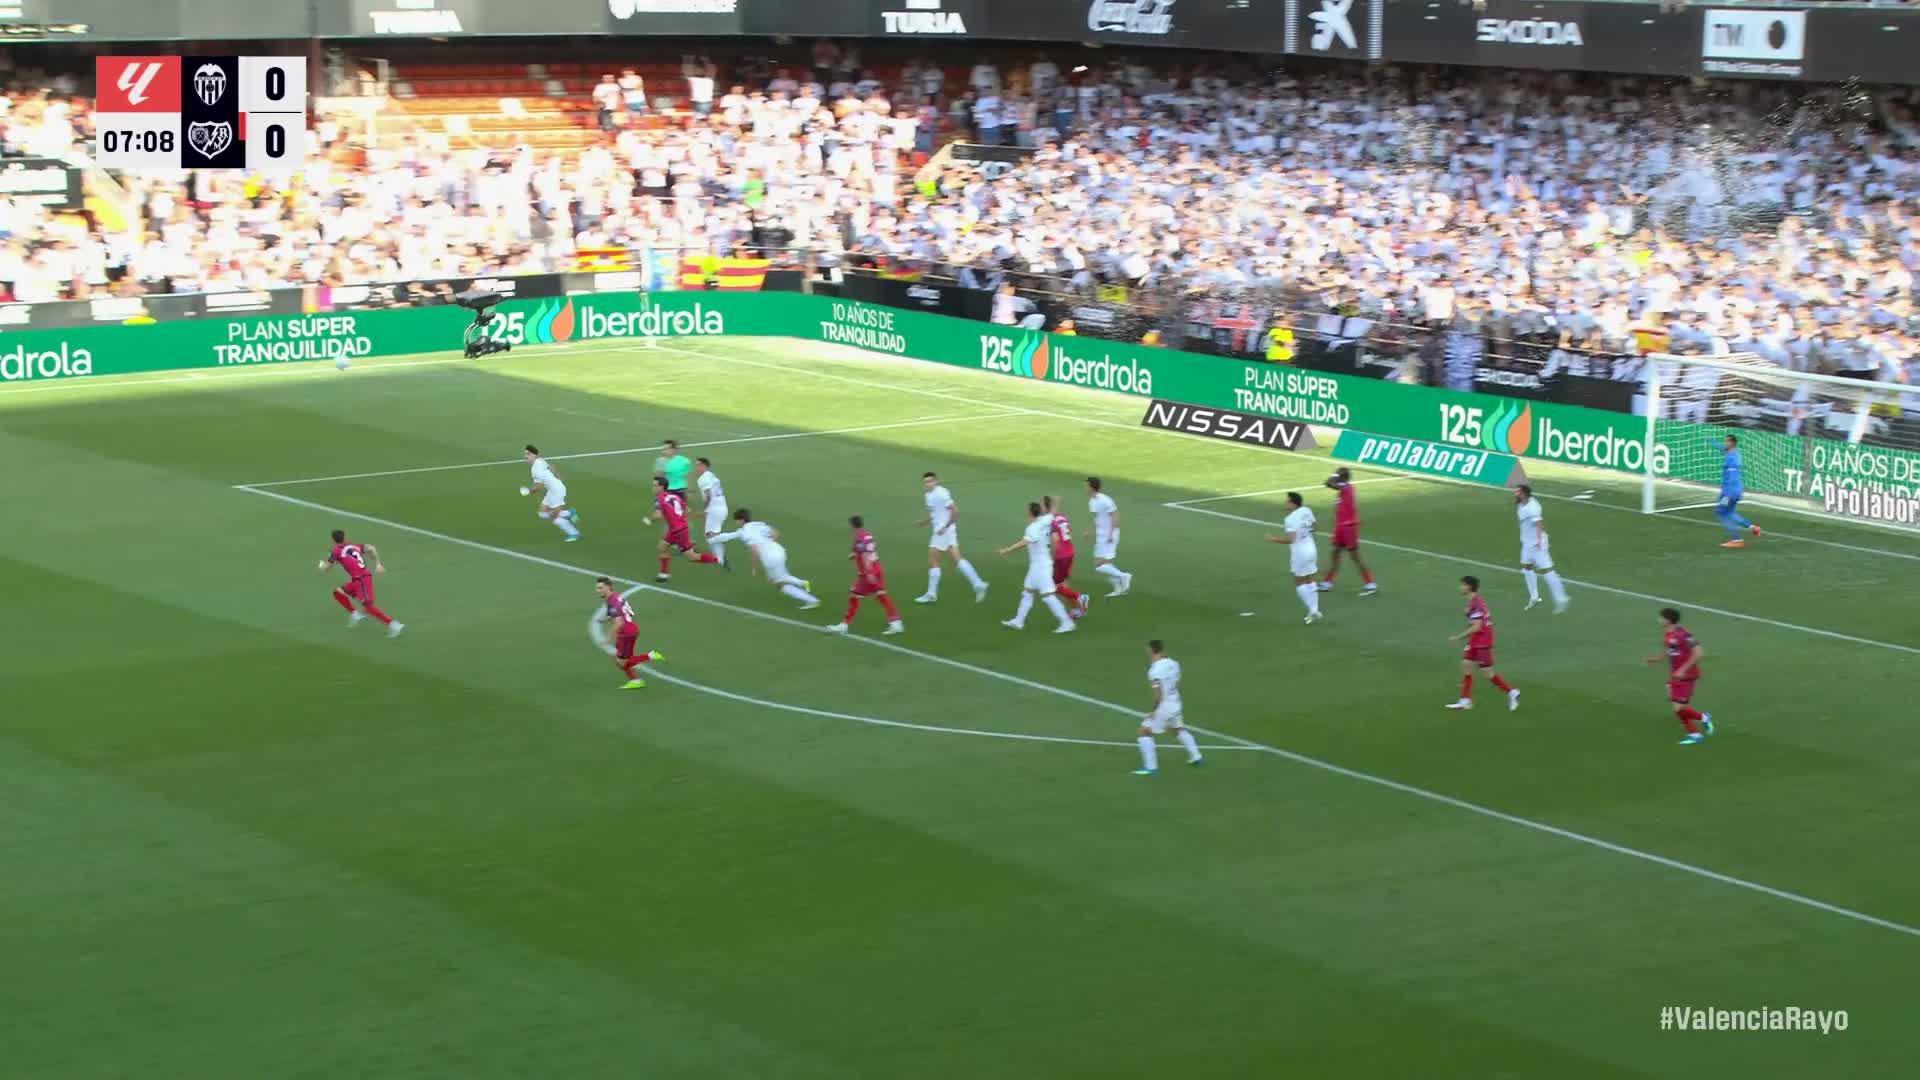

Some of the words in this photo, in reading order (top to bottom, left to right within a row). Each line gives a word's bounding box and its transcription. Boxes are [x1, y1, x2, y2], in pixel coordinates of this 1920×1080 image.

[228, 320, 284, 342] PLAN
[287, 313, 357, 339] SÚPER
[581, 302, 723, 339] Iberdrola
[832, 303, 846, 321] 10
[847, 301, 878, 328] AÑOS
[878, 310, 895, 331] DE
[213, 336, 372, 365] TRANQUILIDAD
[820, 321, 906, 353] TRANQUILIDAD
[980, 335, 1014, 373] 125
[0, 341, 92, 381] drola
[1053, 346, 1152, 395] Iberdrola
[1244, 366, 1285, 392] PLAN
[1287, 369, 1339, 401] SÚPER
[1233, 387, 1351, 425] TRANQUILIDAD
[1439, 403, 1483, 447] 125
[1147, 402, 1300, 449] NISSAN
[1357, 437, 1489, 478] prolaboral
[1828, 443, 1889, 479] AÑOS
[1892, 456, 1920, 485] DE
